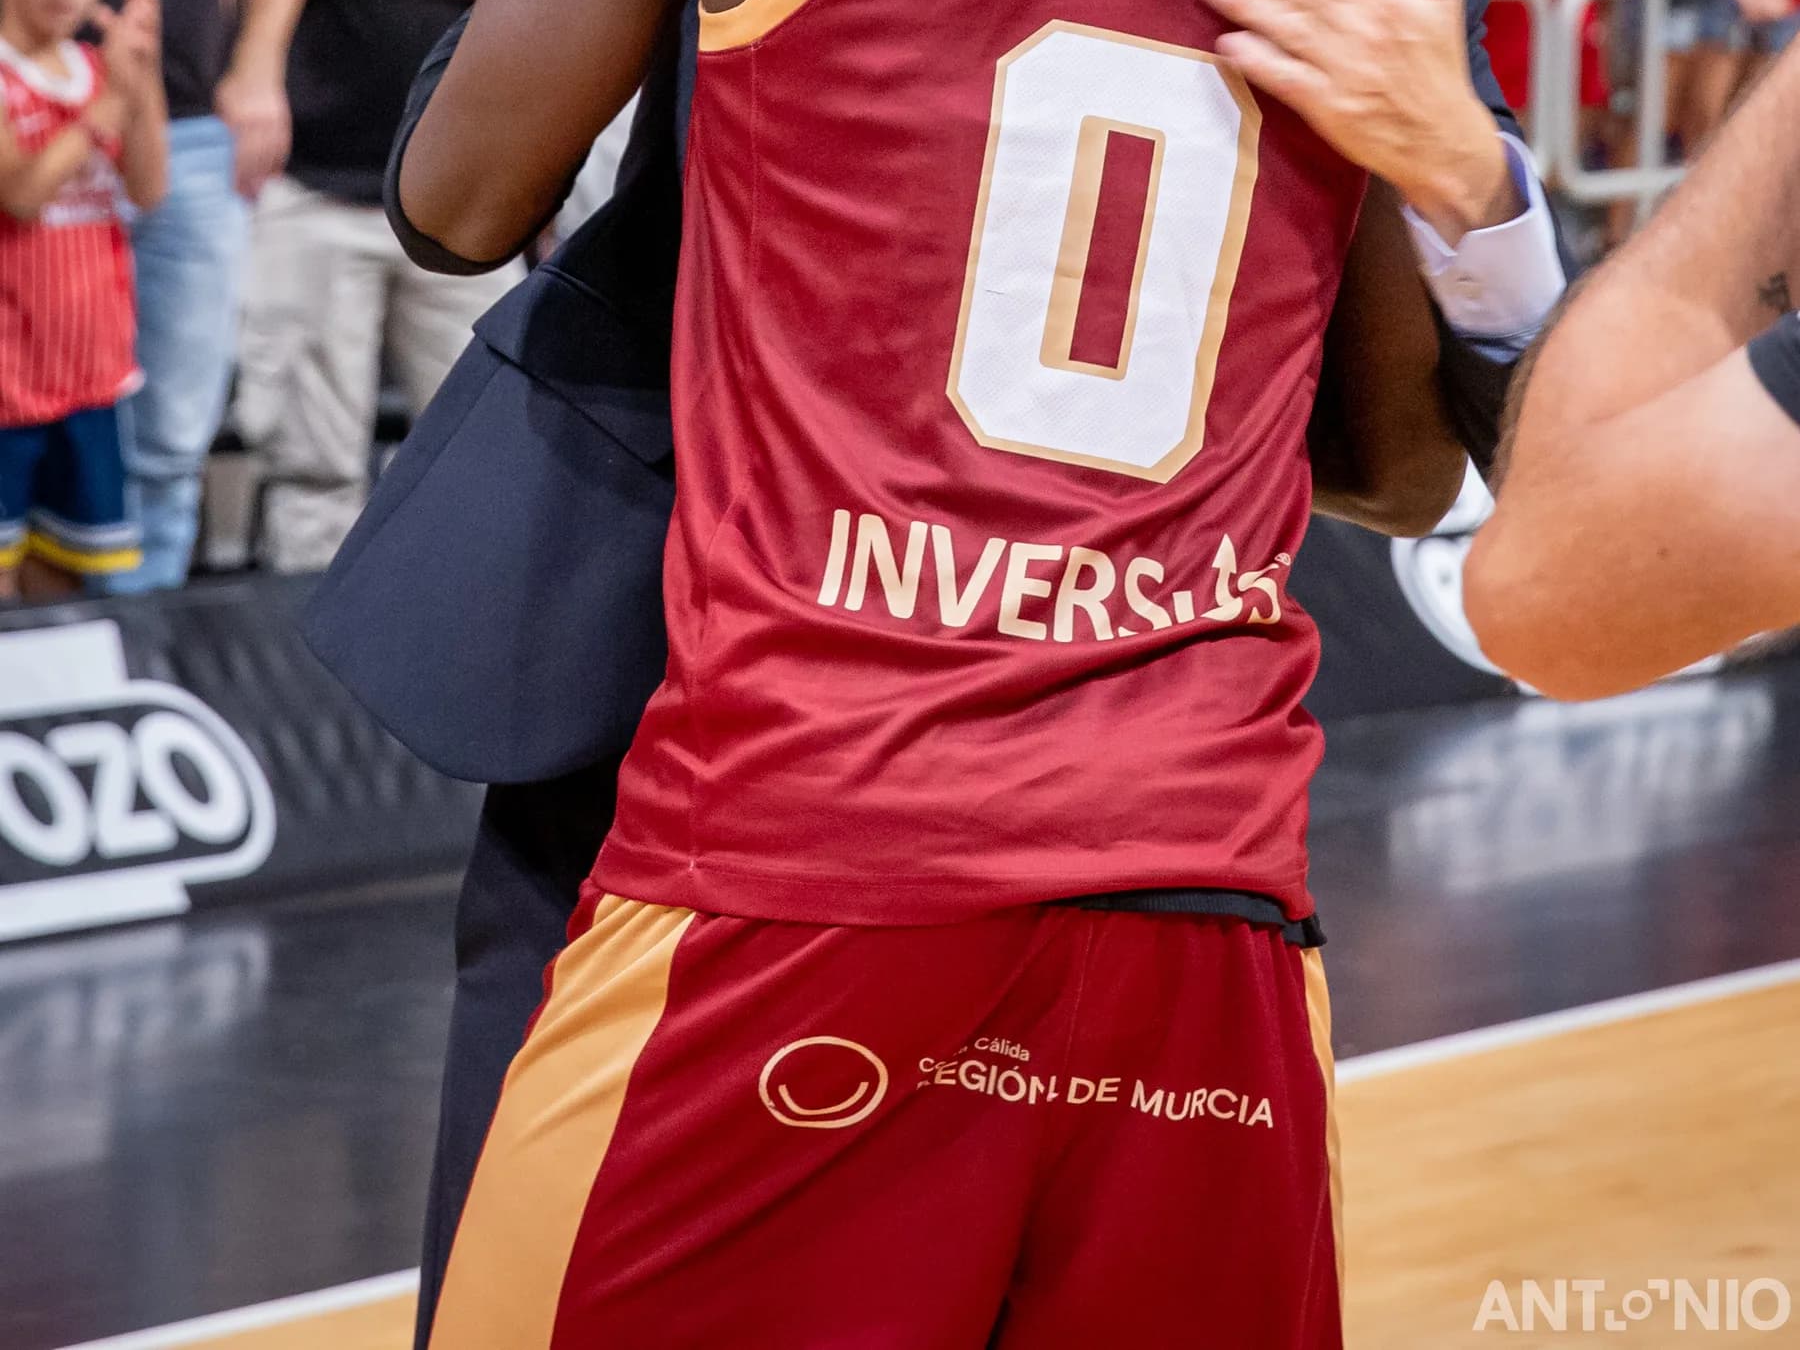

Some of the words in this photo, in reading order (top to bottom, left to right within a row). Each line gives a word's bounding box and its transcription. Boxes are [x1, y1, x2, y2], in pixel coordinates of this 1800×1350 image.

[947, 19, 1263, 484] 0
[973, 1037, 1031, 1062] Cálida
[917, 1059, 1058, 1105] EGIÓN
[1066, 1076, 1121, 1105] DE
[1130, 1079, 1273, 1128] MURCIA
